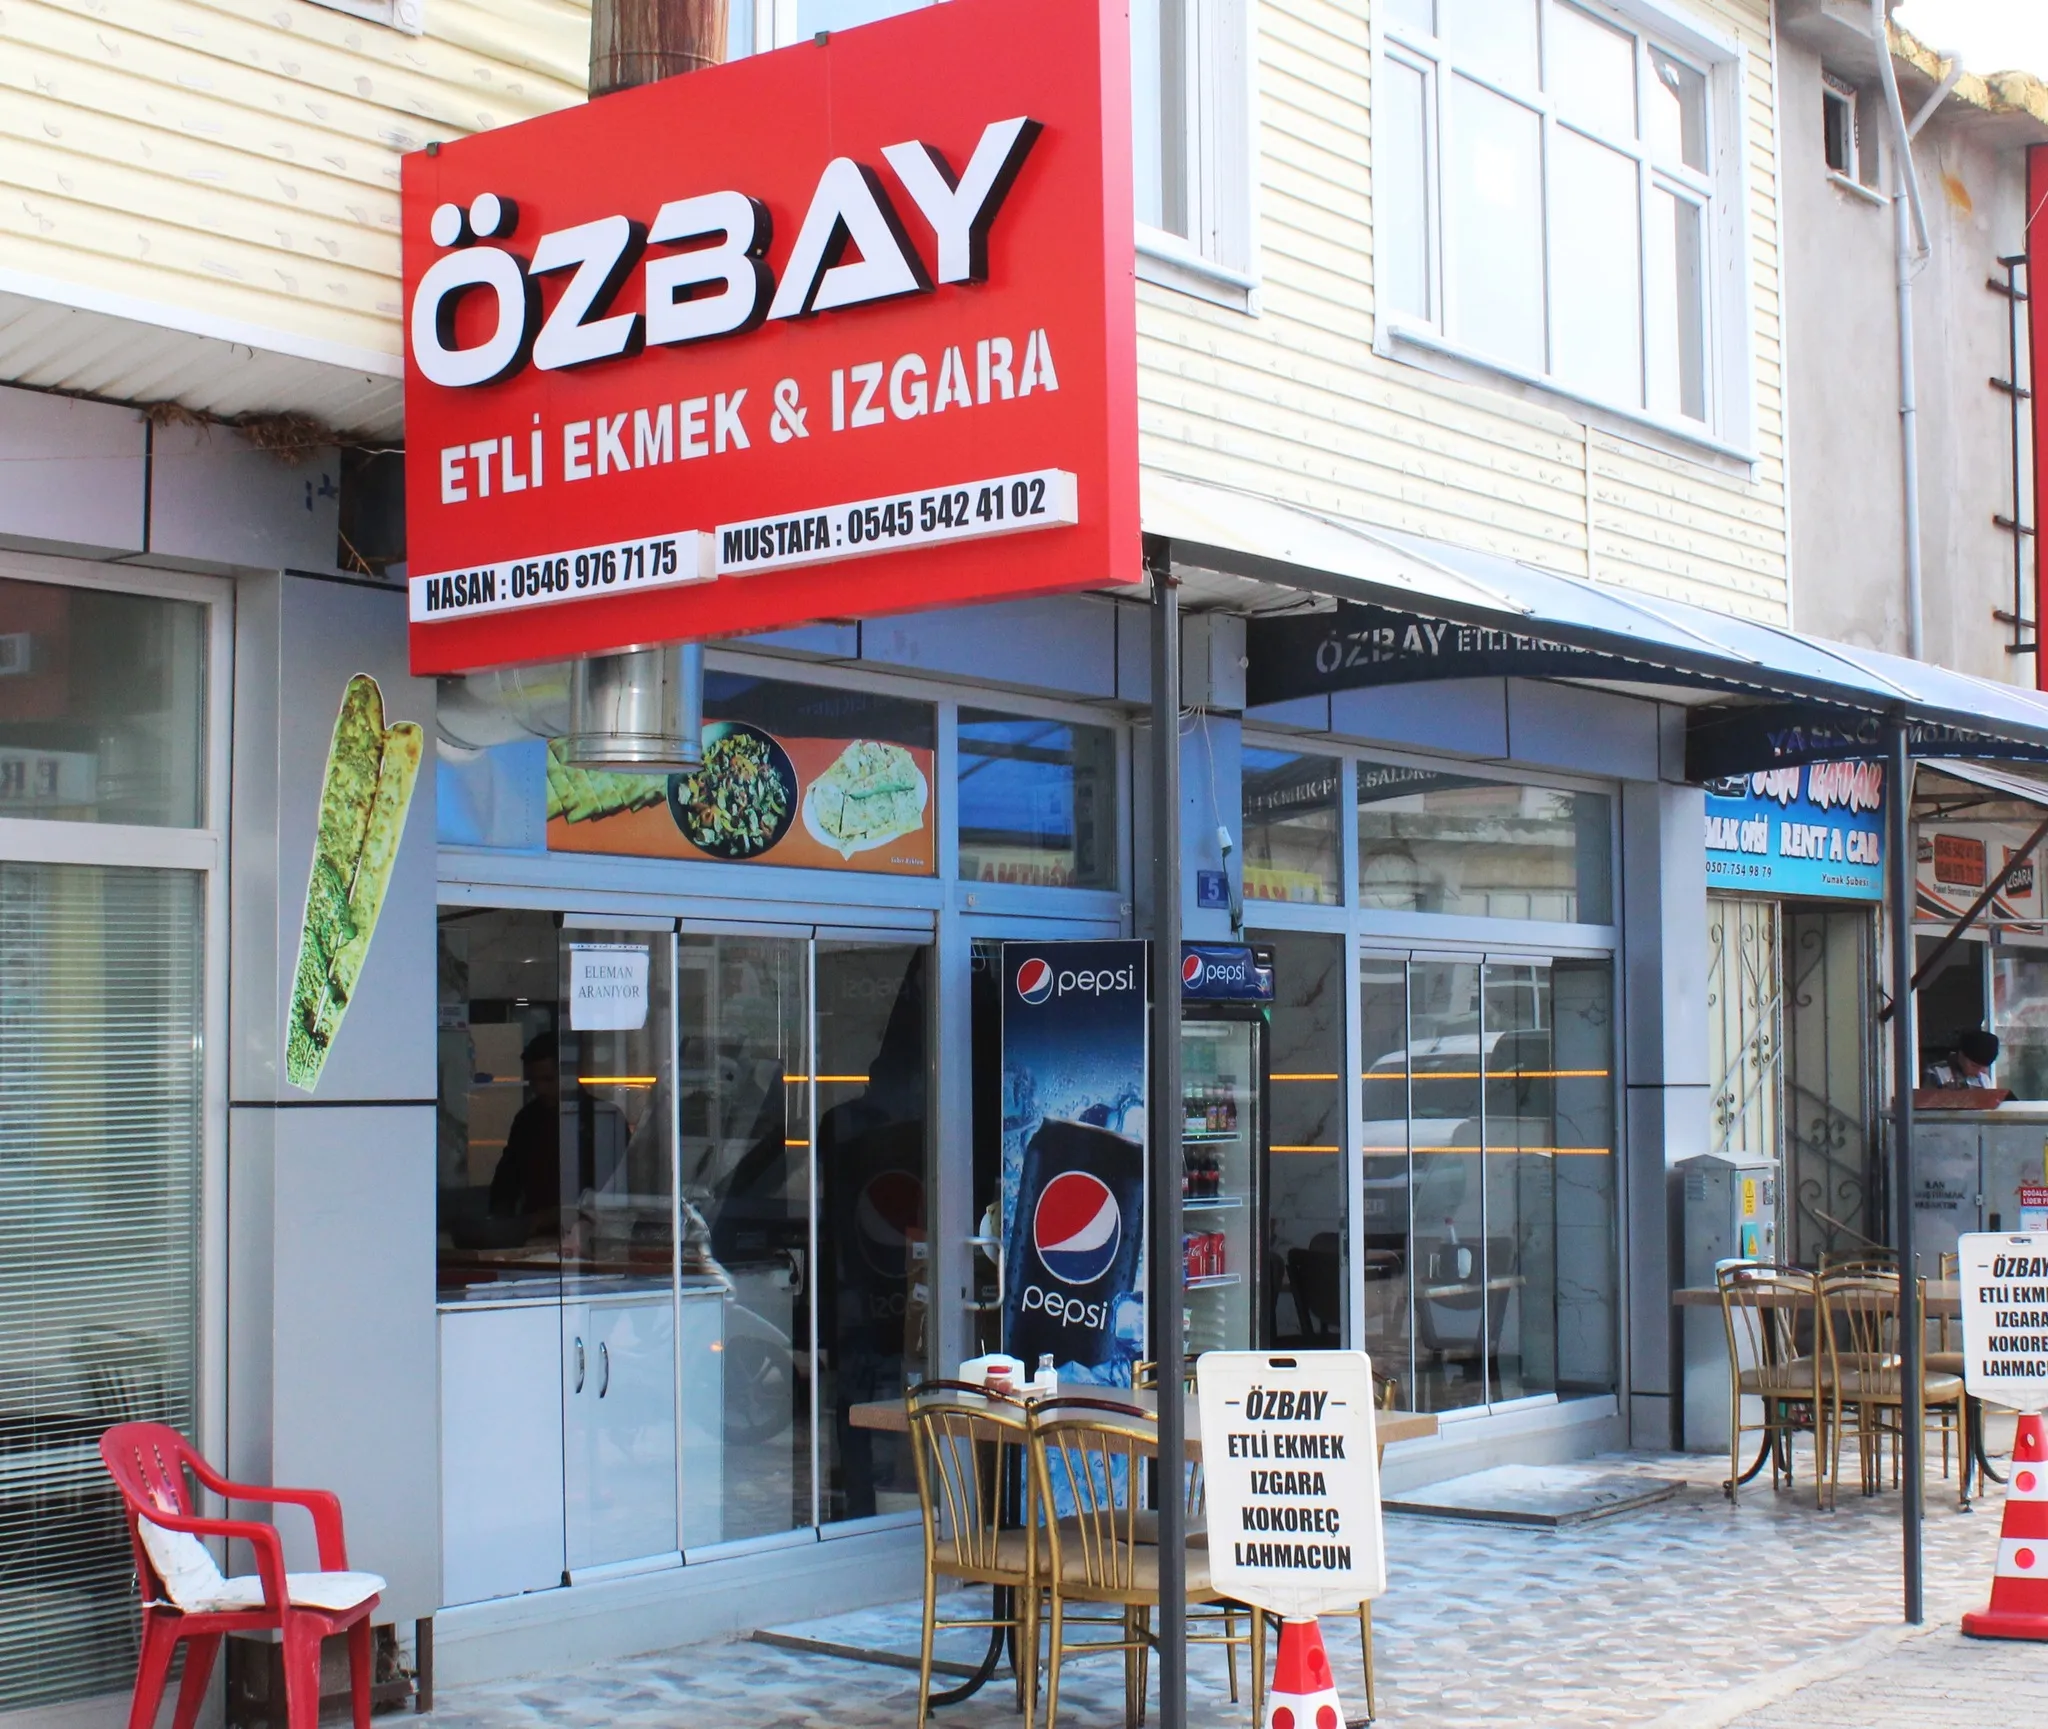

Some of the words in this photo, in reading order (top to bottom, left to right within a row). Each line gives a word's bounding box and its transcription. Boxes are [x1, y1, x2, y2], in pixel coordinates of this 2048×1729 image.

[411, 115, 1043, 389] ÖZBAY
[441, 413, 544, 504] ETLİ
[564, 388, 750, 481] EKMEK
[770, 378, 809, 443] &
[832, 328, 1059, 432] IZGARA
[723, 515, 830, 564] MUSTAFA
[848, 501, 914, 544] 0545
[920, 491, 969, 532] 542
[976, 485, 1004, 521] 41
[1011, 478, 1046, 518] 02
[426, 570, 495, 612] HASAN
[511, 558, 569, 599] 0546
[575, 550, 616, 588] 976
[622, 545, 644, 581] 71
[650, 540, 677, 576] 75
[1779, 821, 1828, 860] RENT
[1829, 827, 1842, 862] A
[1846, 830, 1880, 865] CAR
[1207, 878, 1220, 900] 5
[585, 966, 634, 979] ELEMAN
[1058, 964, 1136, 997] pepsi
[1206, 961, 1246, 985] pepsi
[578, 985, 640, 999] ARANIYOR
[1021, 1285, 1108, 1331] pepsi
[1979, 1284, 2009, 1303] ETLİ
[2013, 1286, 2048, 1303] EKM
[1982, 1360, 2048, 1377] LAHMAC
[1245, 1385, 1328, 1421] ÖZBAY
[1228, 1429, 1268, 1458] ETLİ
[1273, 1434, 1346, 1460] EKMEK
[1251, 1470, 1327, 1496] IZGARA
[1241, 1507, 1340, 1538] KOKOREÇ
[1234, 1542, 1352, 1570] LAHMACUN
